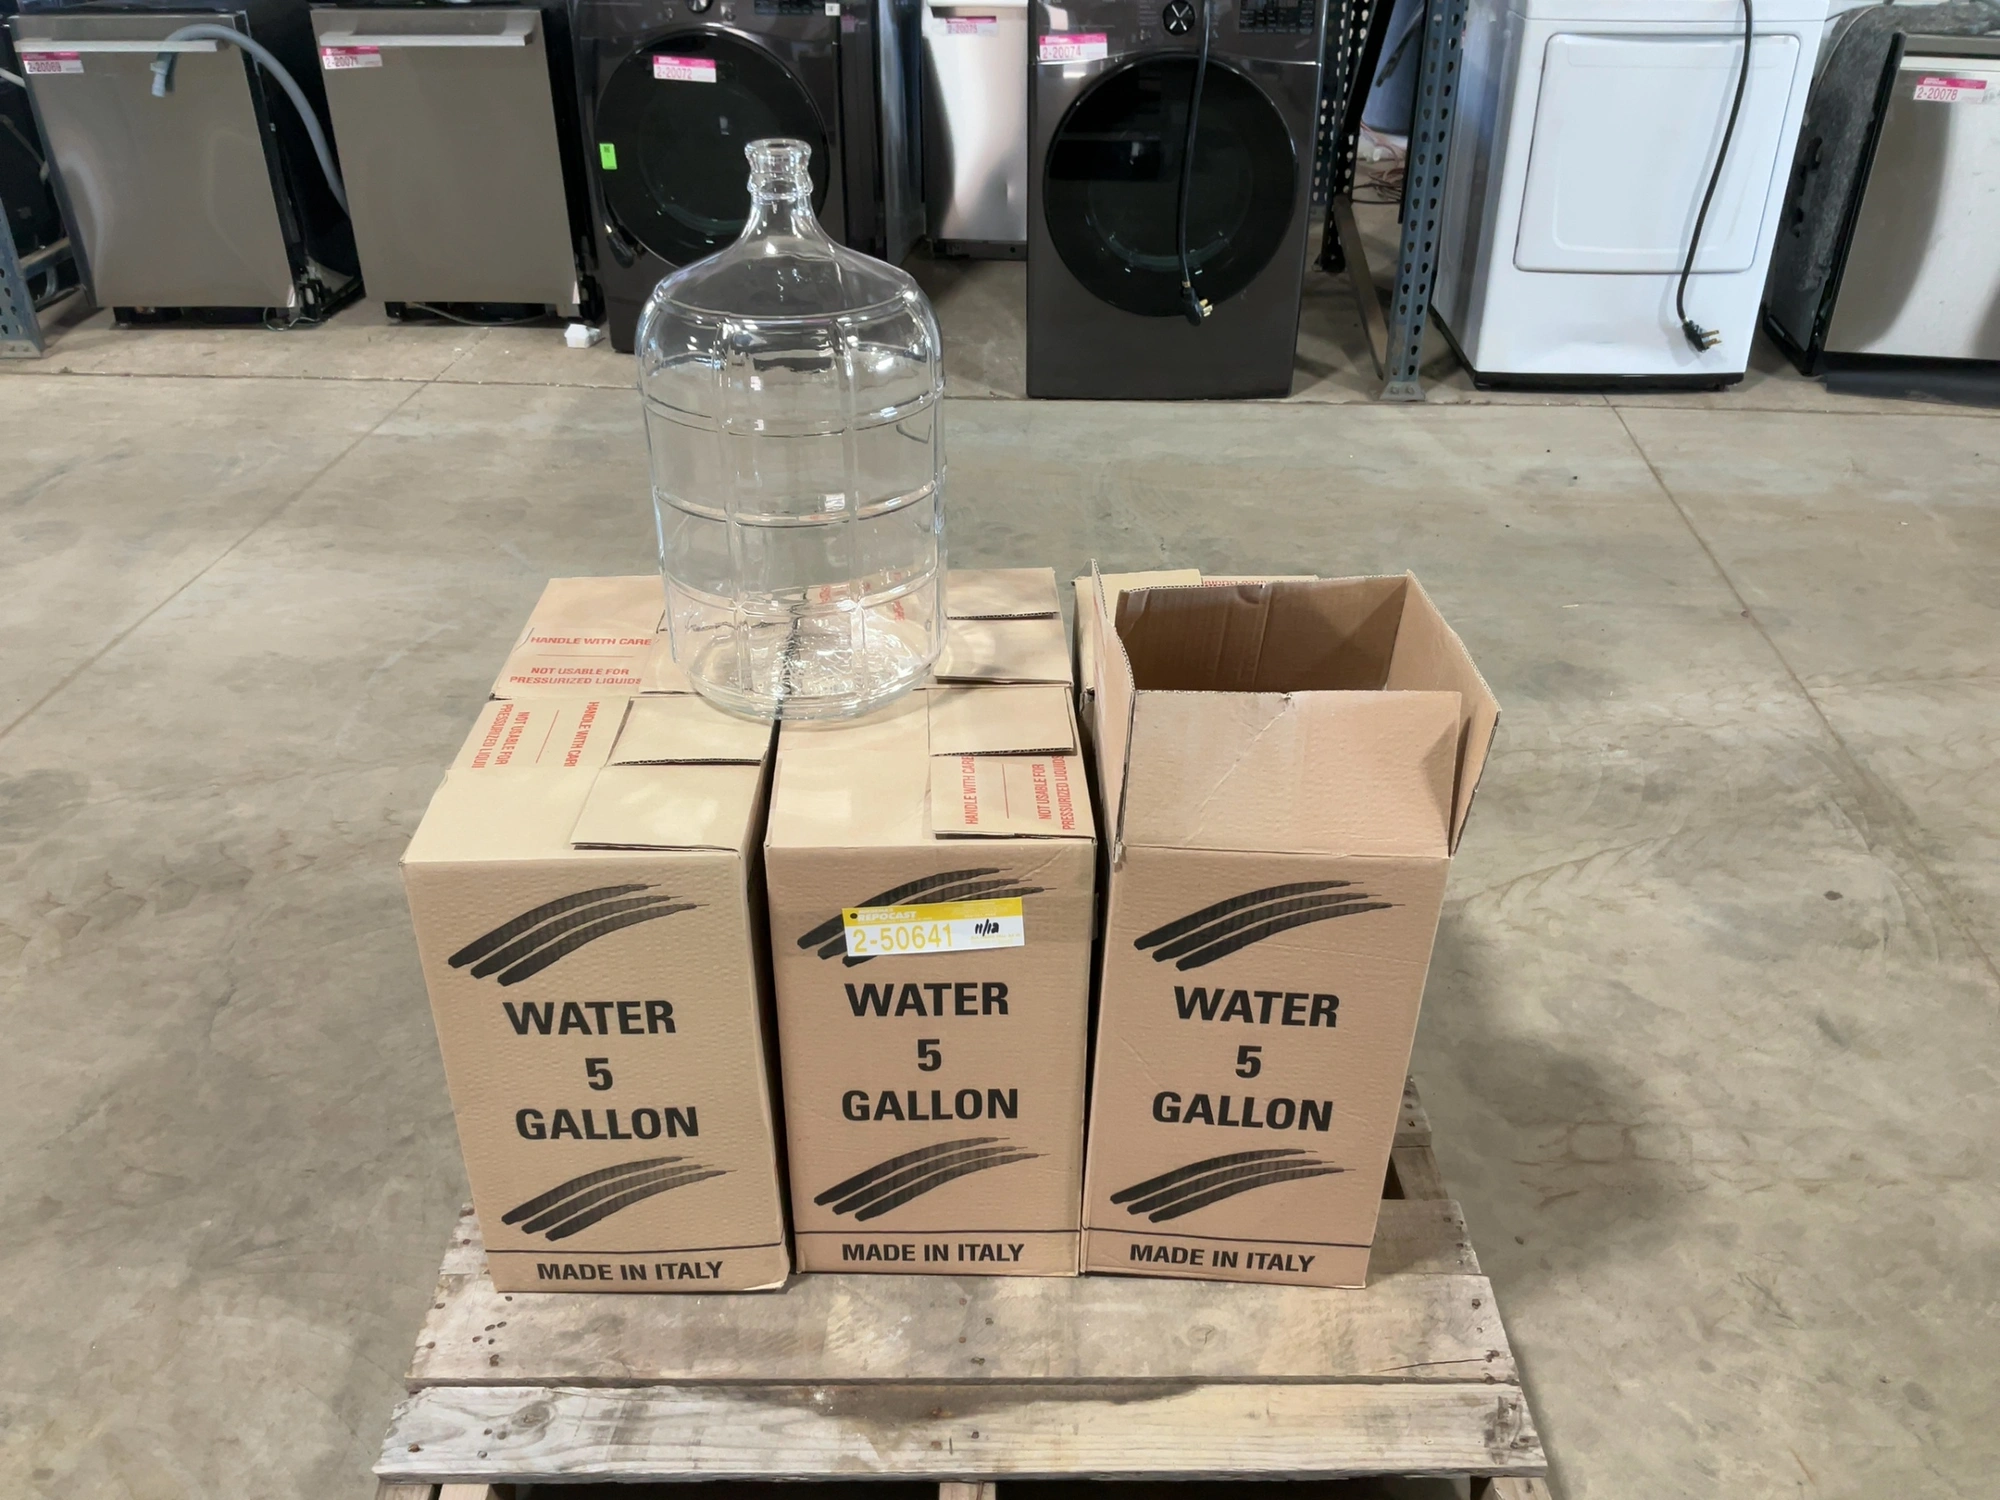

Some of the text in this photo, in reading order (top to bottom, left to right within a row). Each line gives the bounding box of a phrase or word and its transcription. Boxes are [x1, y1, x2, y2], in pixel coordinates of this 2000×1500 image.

[1042, 45, 1082, 59] 2-20074
[656, 66, 693, 80] 2-20072
[1916, 86, 1959, 101] 2-20078
[530, 637, 652, 646] HANDLE WITH CARE
[509, 676, 642, 685] PRESSURIZED LIQUIDS
[530, 667, 630, 676] NOT USABLE FOR
[579, 701, 600, 729] HANDLE
[471, 703, 514, 768] PRESSURIZED LIQUI
[494, 711, 530, 765] NOT USABLE FOR
[570, 729, 589, 748] WITH
[961, 755, 978, 825] HANDLE WITH CARE
[1031, 763, 1052, 820] NOT USABLE FOR
[1052, 756, 1075, 830] PRESSURIZED LIQUIDS
[857, 911, 917, 922] REPOCAST
[852, 924, 952, 953] 2-50641
[843, 981, 1009, 1017] WATER
[1173, 985, 1340, 1028] WATER
[502, 1000, 676, 1036] WATER
[917, 1038, 942, 1072] 5
[1235, 1044, 1263, 1079] 5
[584, 1057, 613, 1091] 5
[841, 1088, 1018, 1121] GALLON
[1152, 1091, 1334, 1132] GALLON
[515, 1106, 699, 1140] GALLON
[843, 1243, 1025, 1261] MADE IN ITALY
[1130, 1244, 1316, 1272] MADE IN ITALY
[537, 1262, 722, 1280] MADE IN ITALY
